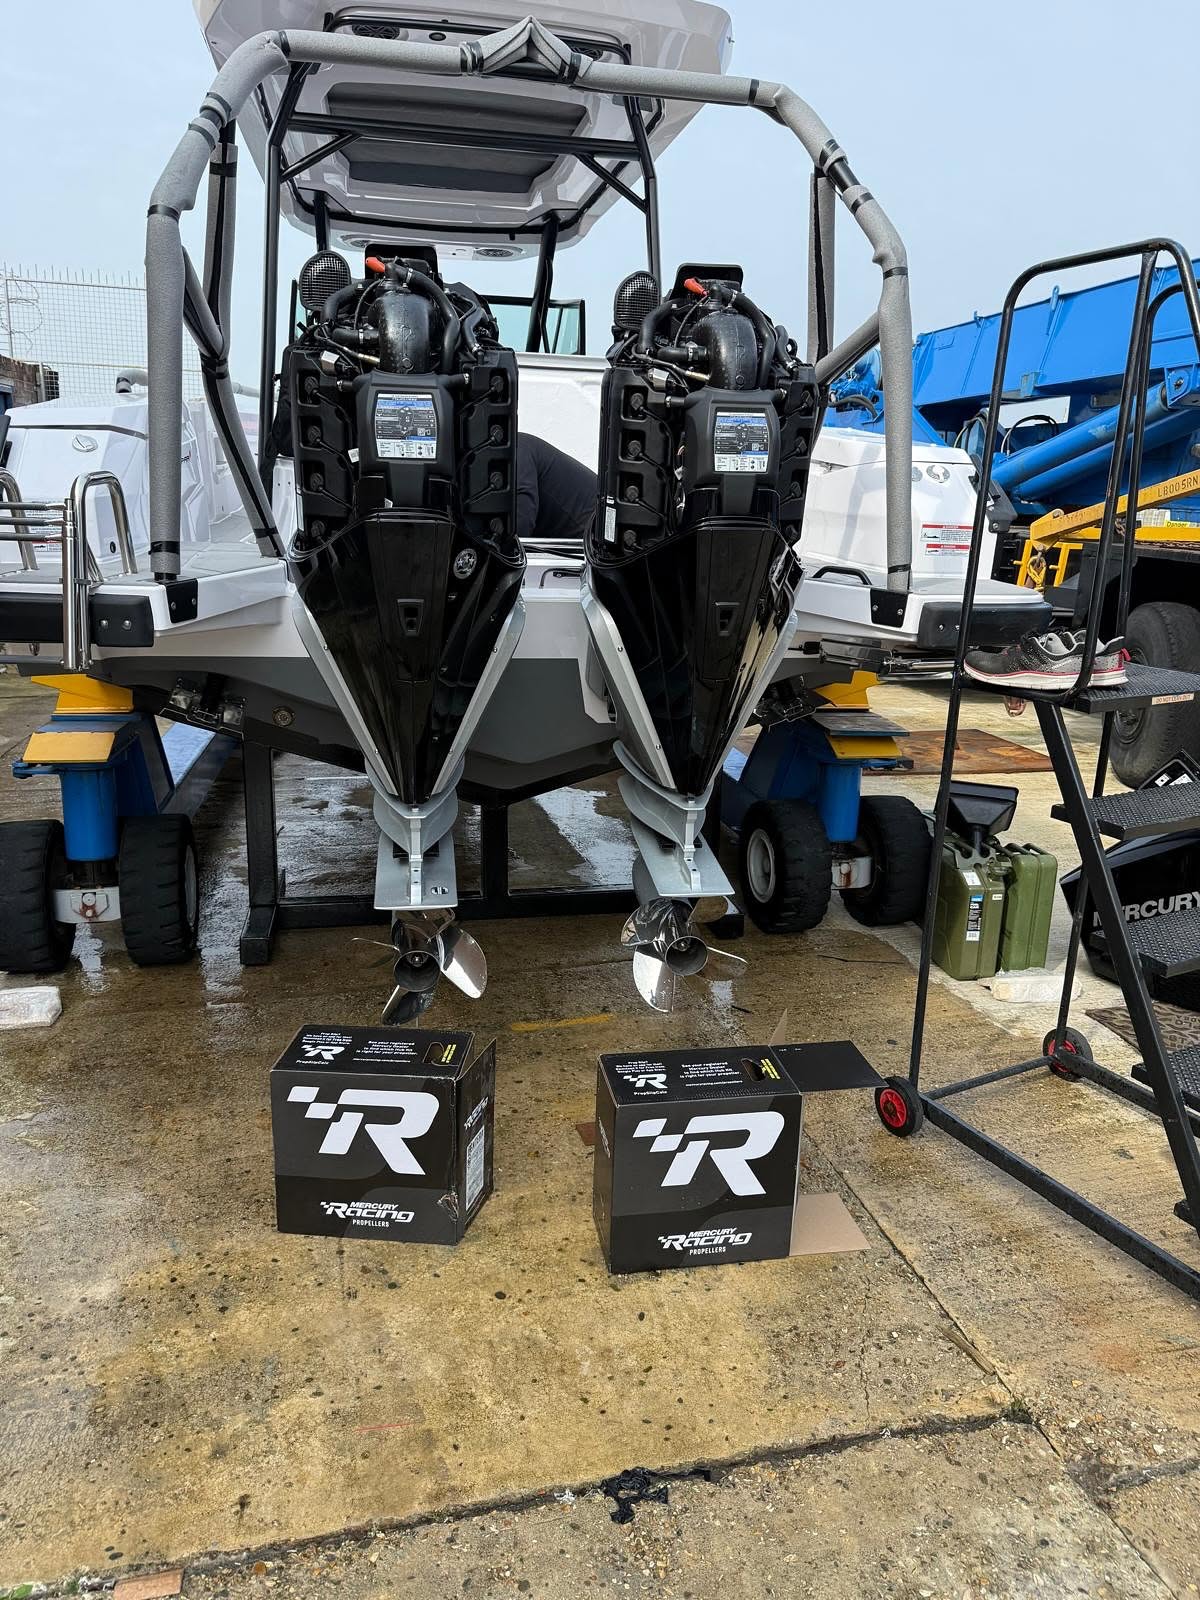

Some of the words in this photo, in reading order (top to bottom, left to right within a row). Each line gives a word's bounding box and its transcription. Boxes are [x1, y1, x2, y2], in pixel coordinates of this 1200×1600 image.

[1092, 891, 1200, 927] MRCURY
[349, 1201, 399, 1211] MERCURY
[352, 1219, 390, 1228] PROPELLERS
[687, 1227, 738, 1239] MERCURY
[689, 1246, 727, 1256] PROPELLERS
